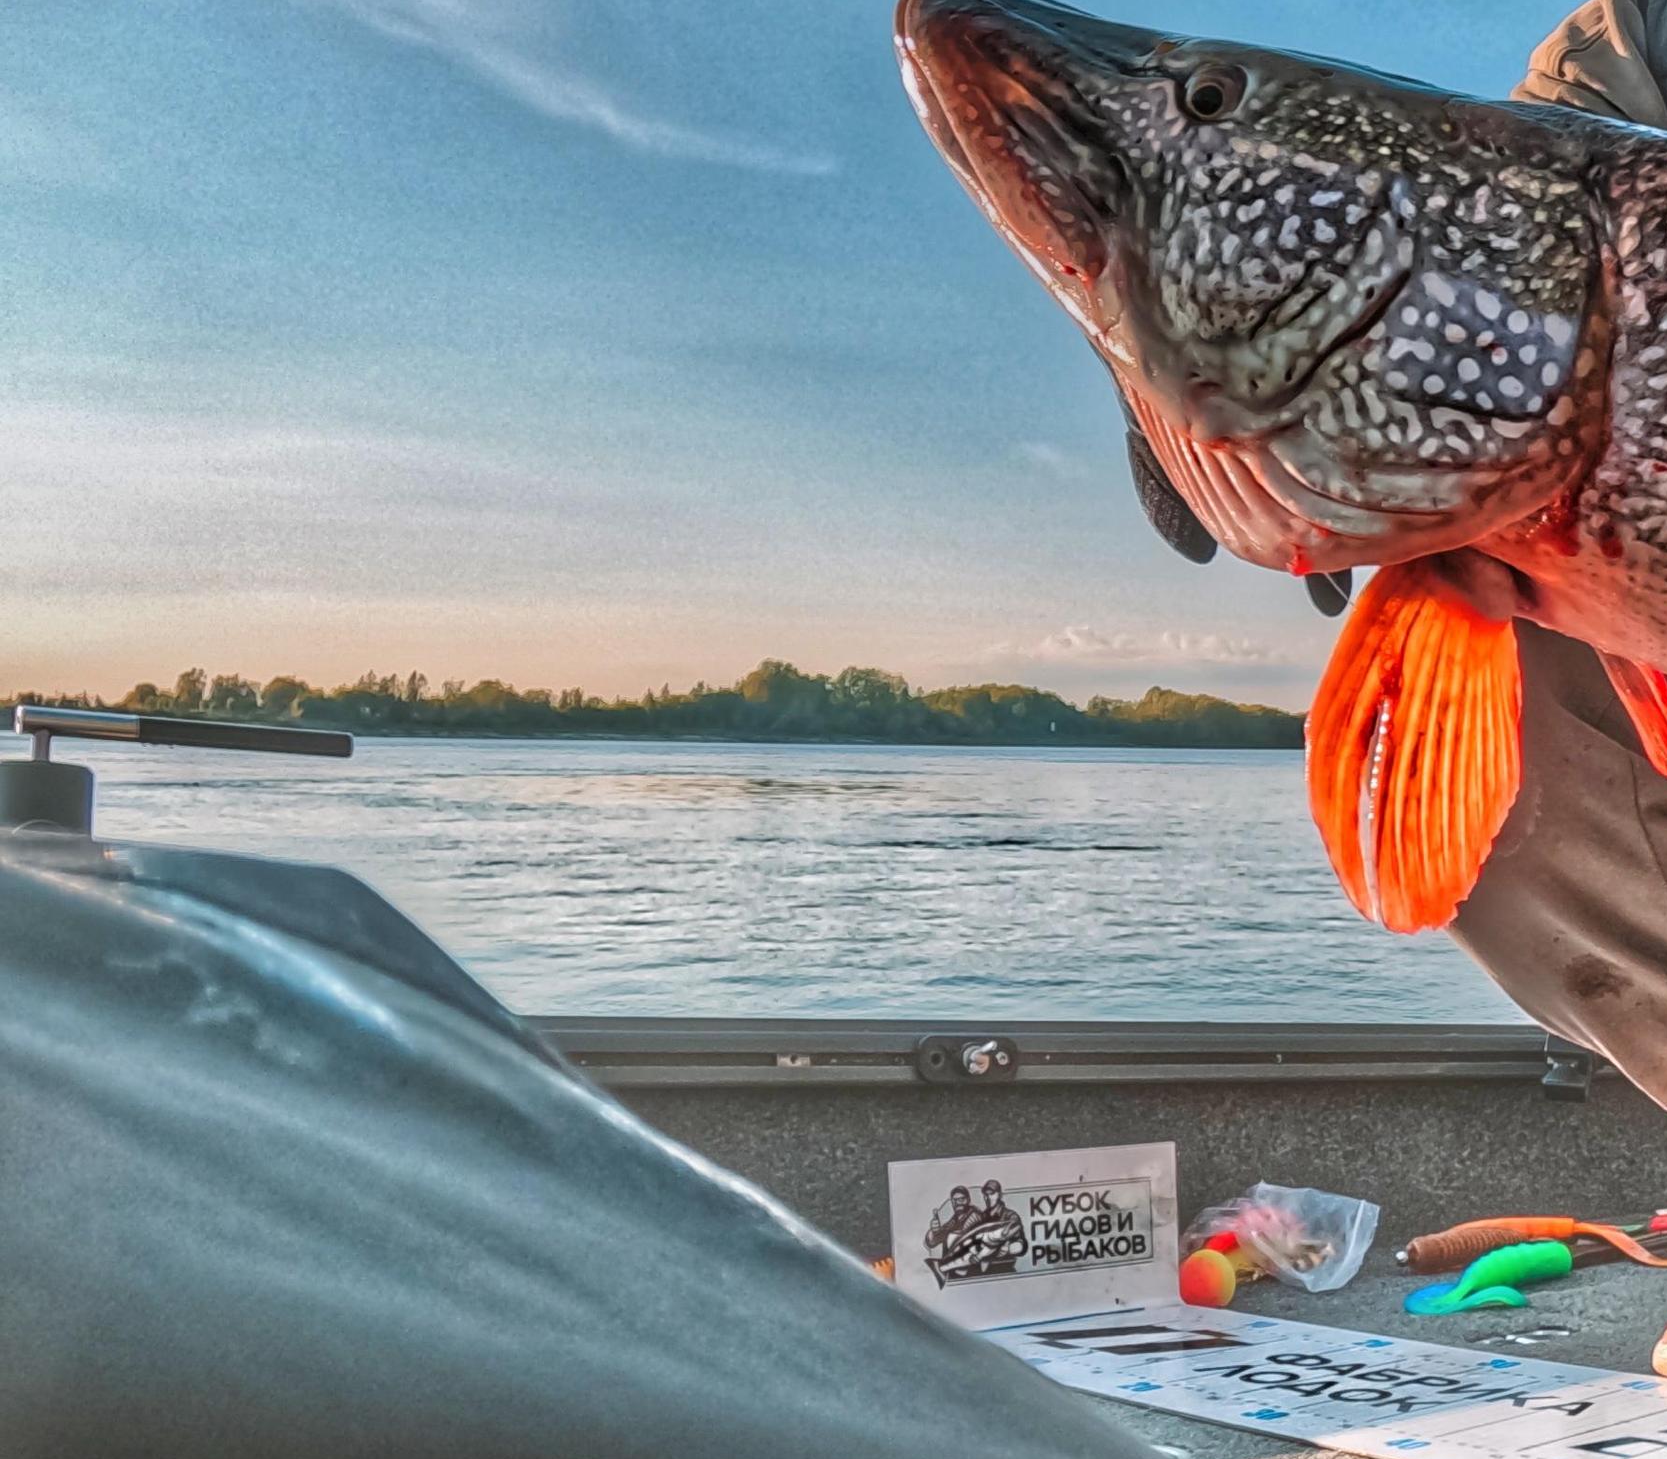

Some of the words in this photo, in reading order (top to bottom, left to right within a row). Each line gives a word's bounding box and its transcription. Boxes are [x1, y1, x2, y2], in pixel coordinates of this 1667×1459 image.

[1030, 1190, 1111, 1217] КУБОК
[1031, 1214, 1112, 1242] ГИДОВ
[1118, 1212, 1133, 1232] И
[1032, 1235, 1146, 1266] РЫБАКОВ
[1192, 1364, 1449, 1413] ЛОДОК
[1265, 1353, 1594, 1416] ФАБРИКА
[1385, 1438, 1432, 1450] 40
